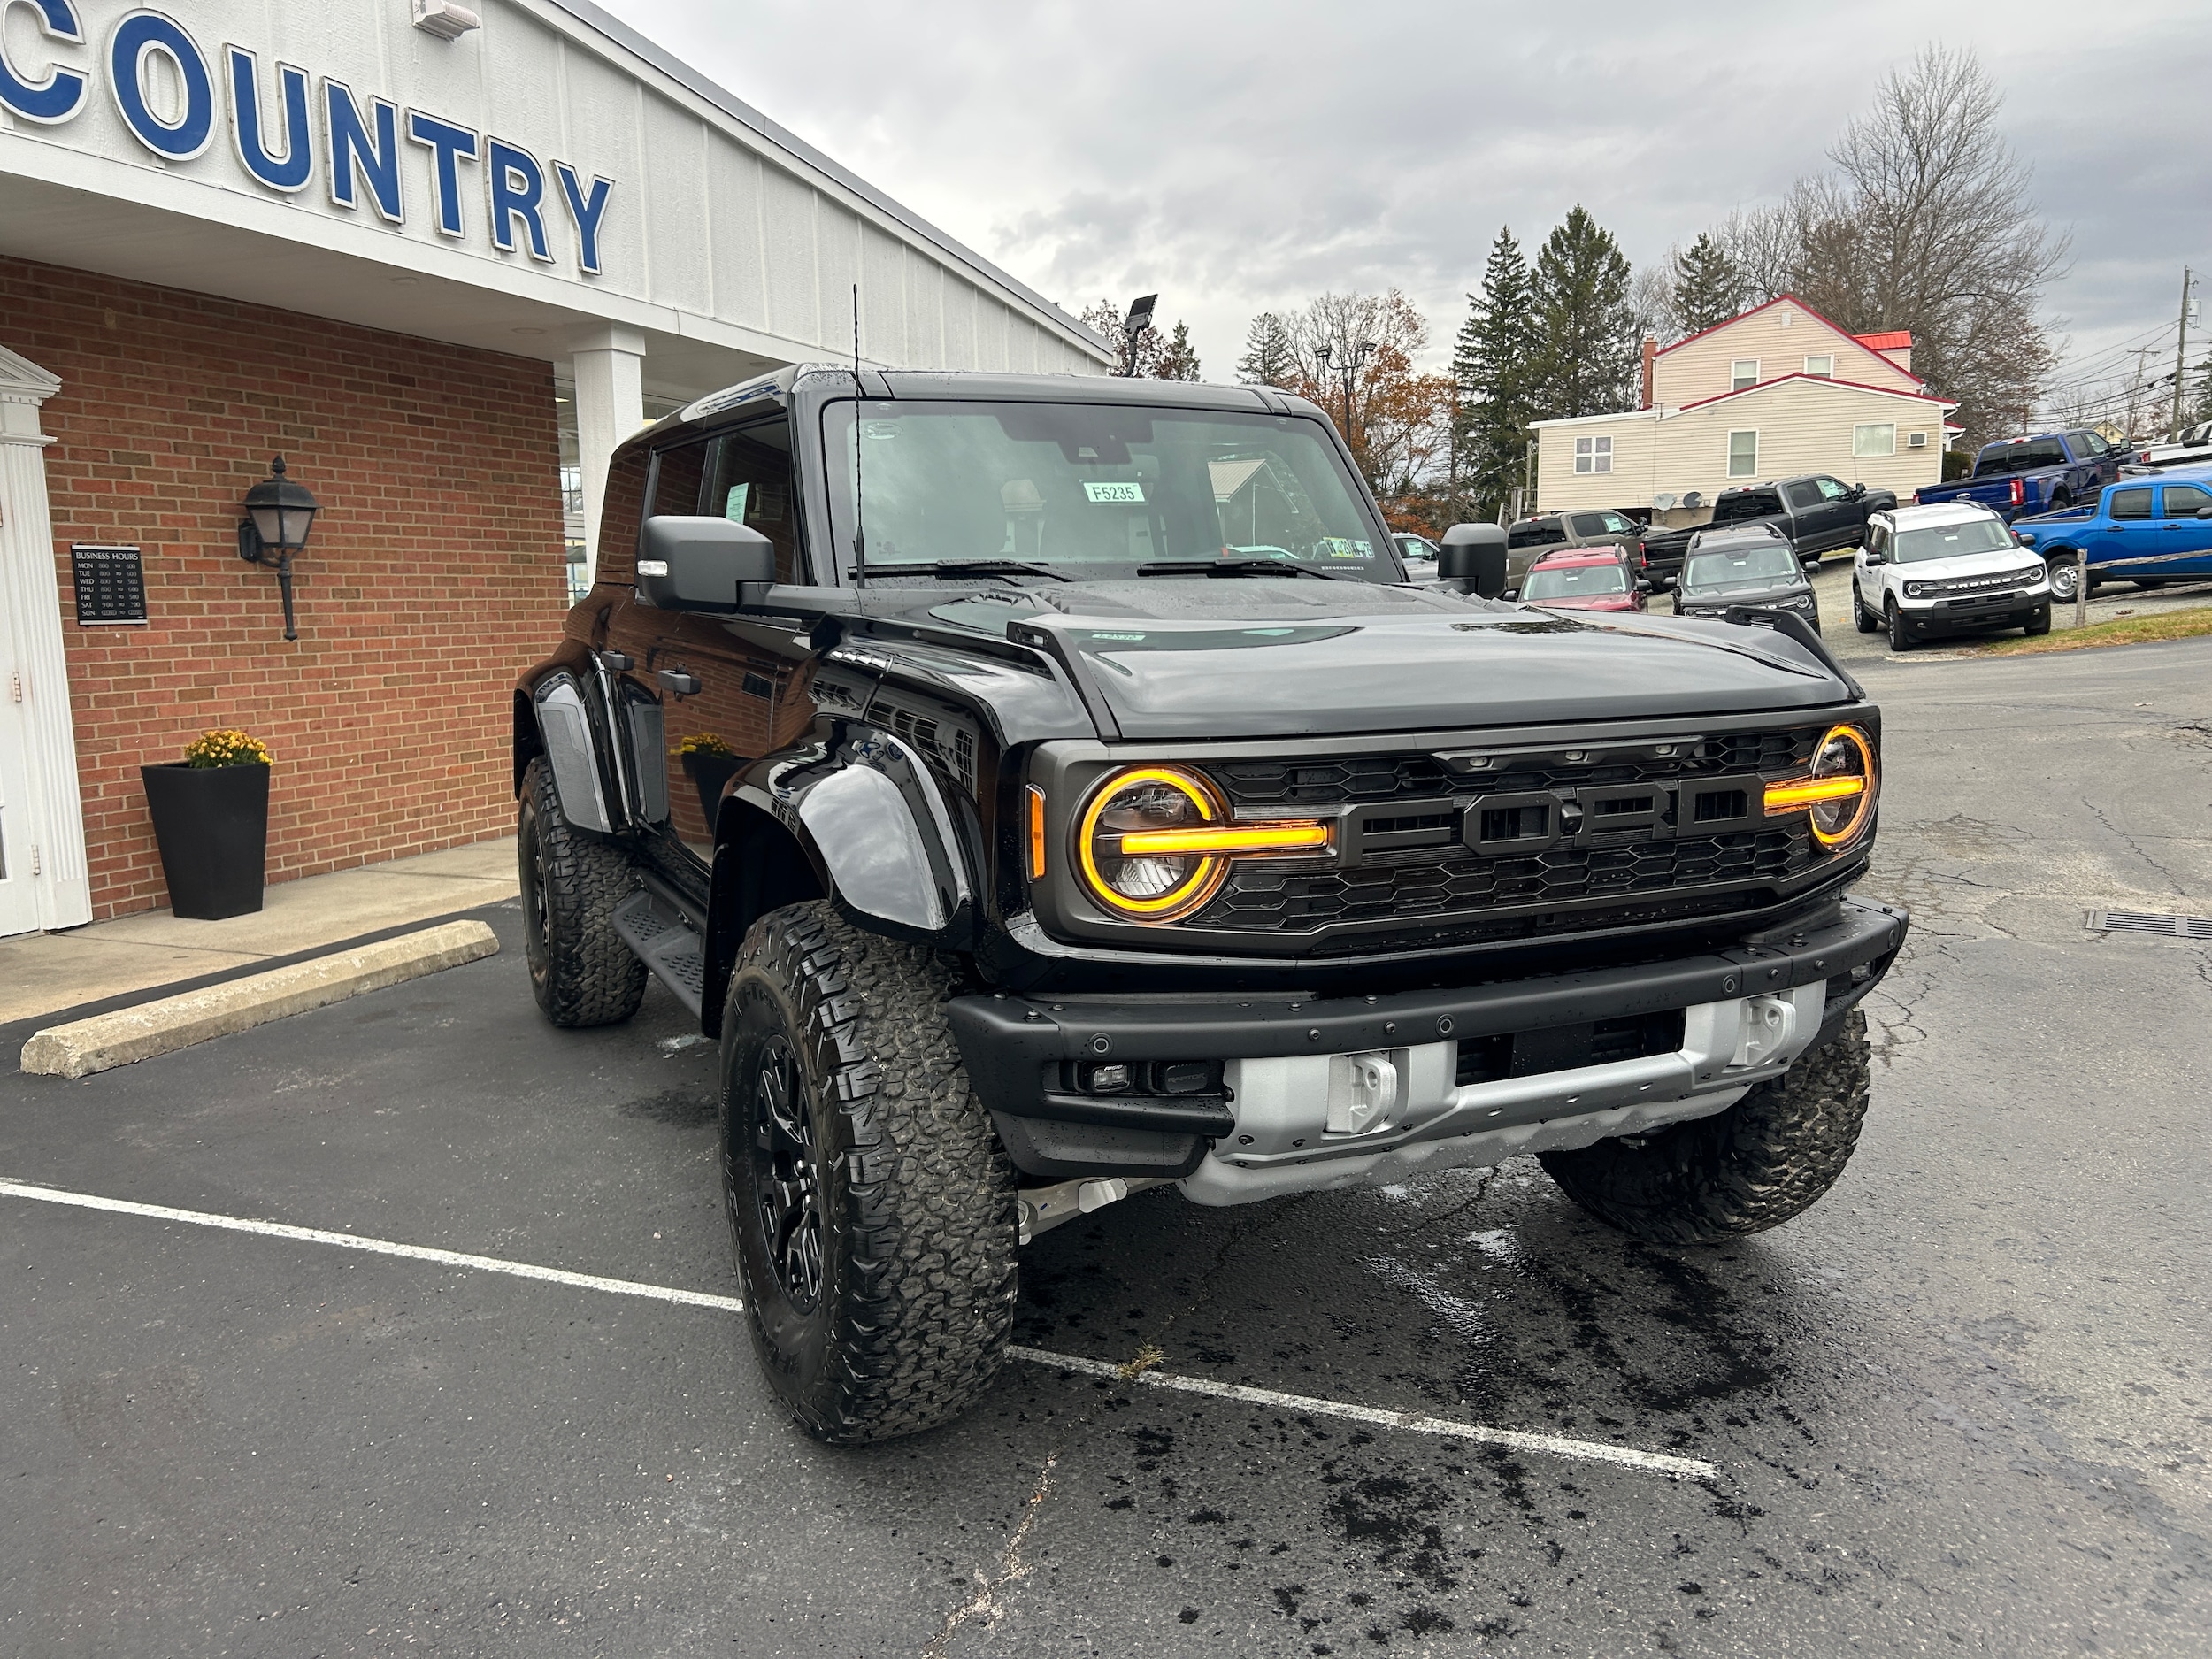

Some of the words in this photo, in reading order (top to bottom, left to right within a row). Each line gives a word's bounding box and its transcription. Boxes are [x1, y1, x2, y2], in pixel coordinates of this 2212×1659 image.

[0, 0, 616, 275] COUNTRY
[1092, 487, 1135, 500] F5235
[75, 551, 111, 560] BUSINESS
[111, 552, 139, 561] HOURS
[1336, 772, 1766, 869] FORD
[1167, 1072, 1207, 1083] RAPTOR
